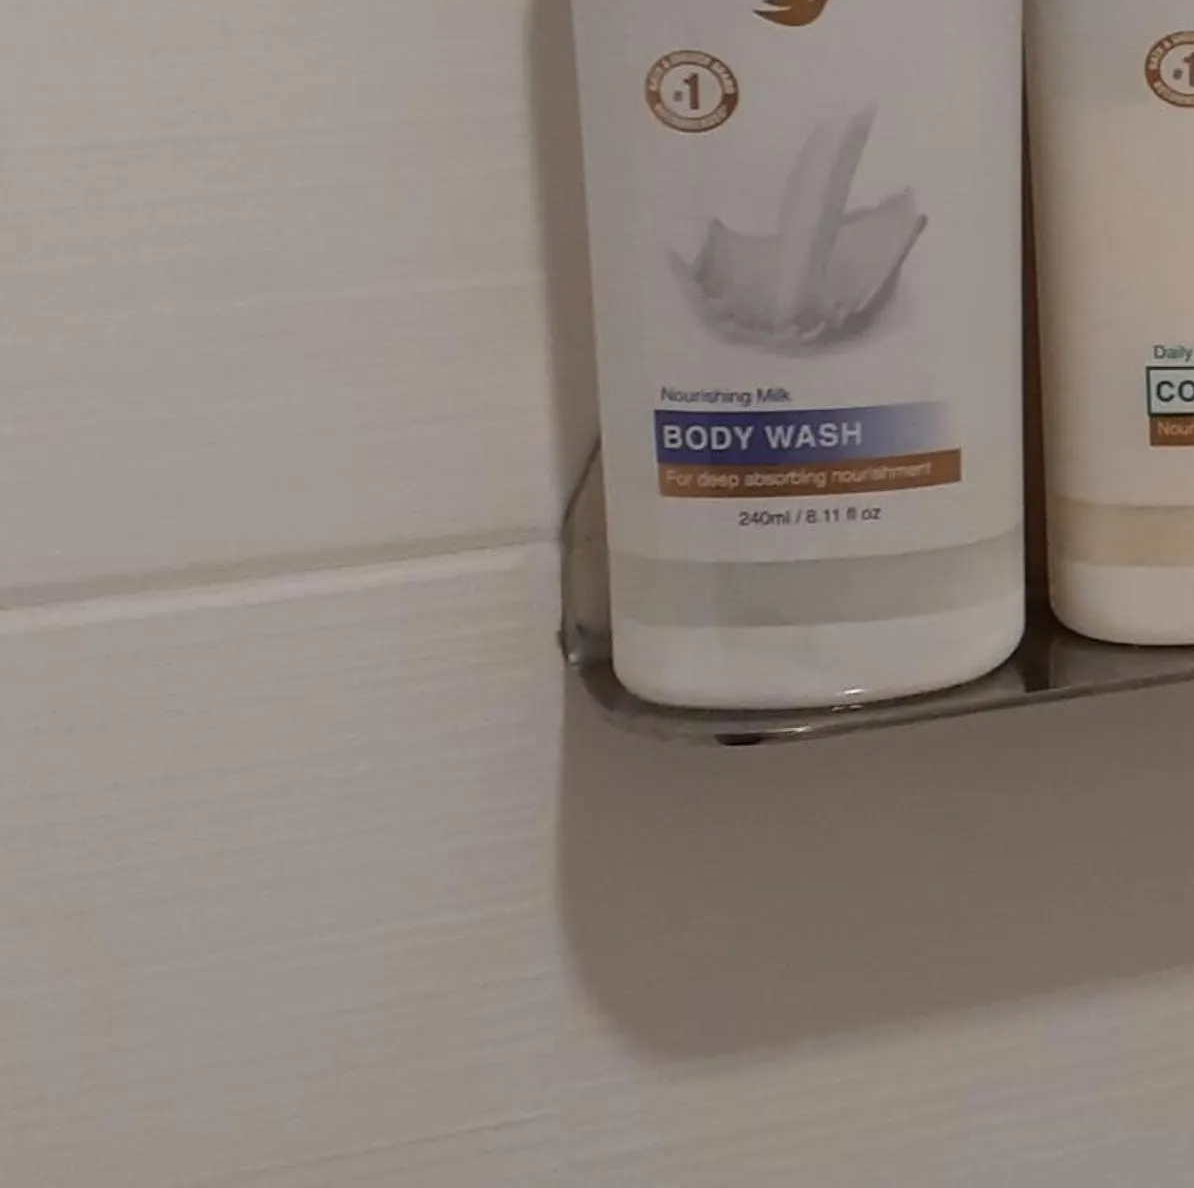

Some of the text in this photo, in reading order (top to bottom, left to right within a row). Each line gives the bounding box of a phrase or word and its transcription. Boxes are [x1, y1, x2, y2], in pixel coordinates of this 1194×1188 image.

[1153, 345, 1193, 362] Daily
[660, 386, 792, 407] Nourishing Milk
[662, 421, 863, 451] BODY WASH
[667, 462, 933, 489] For deep absorbing nourishment
[738, 510, 791, 526] 240ml
[860, 507, 881, 521] oz
